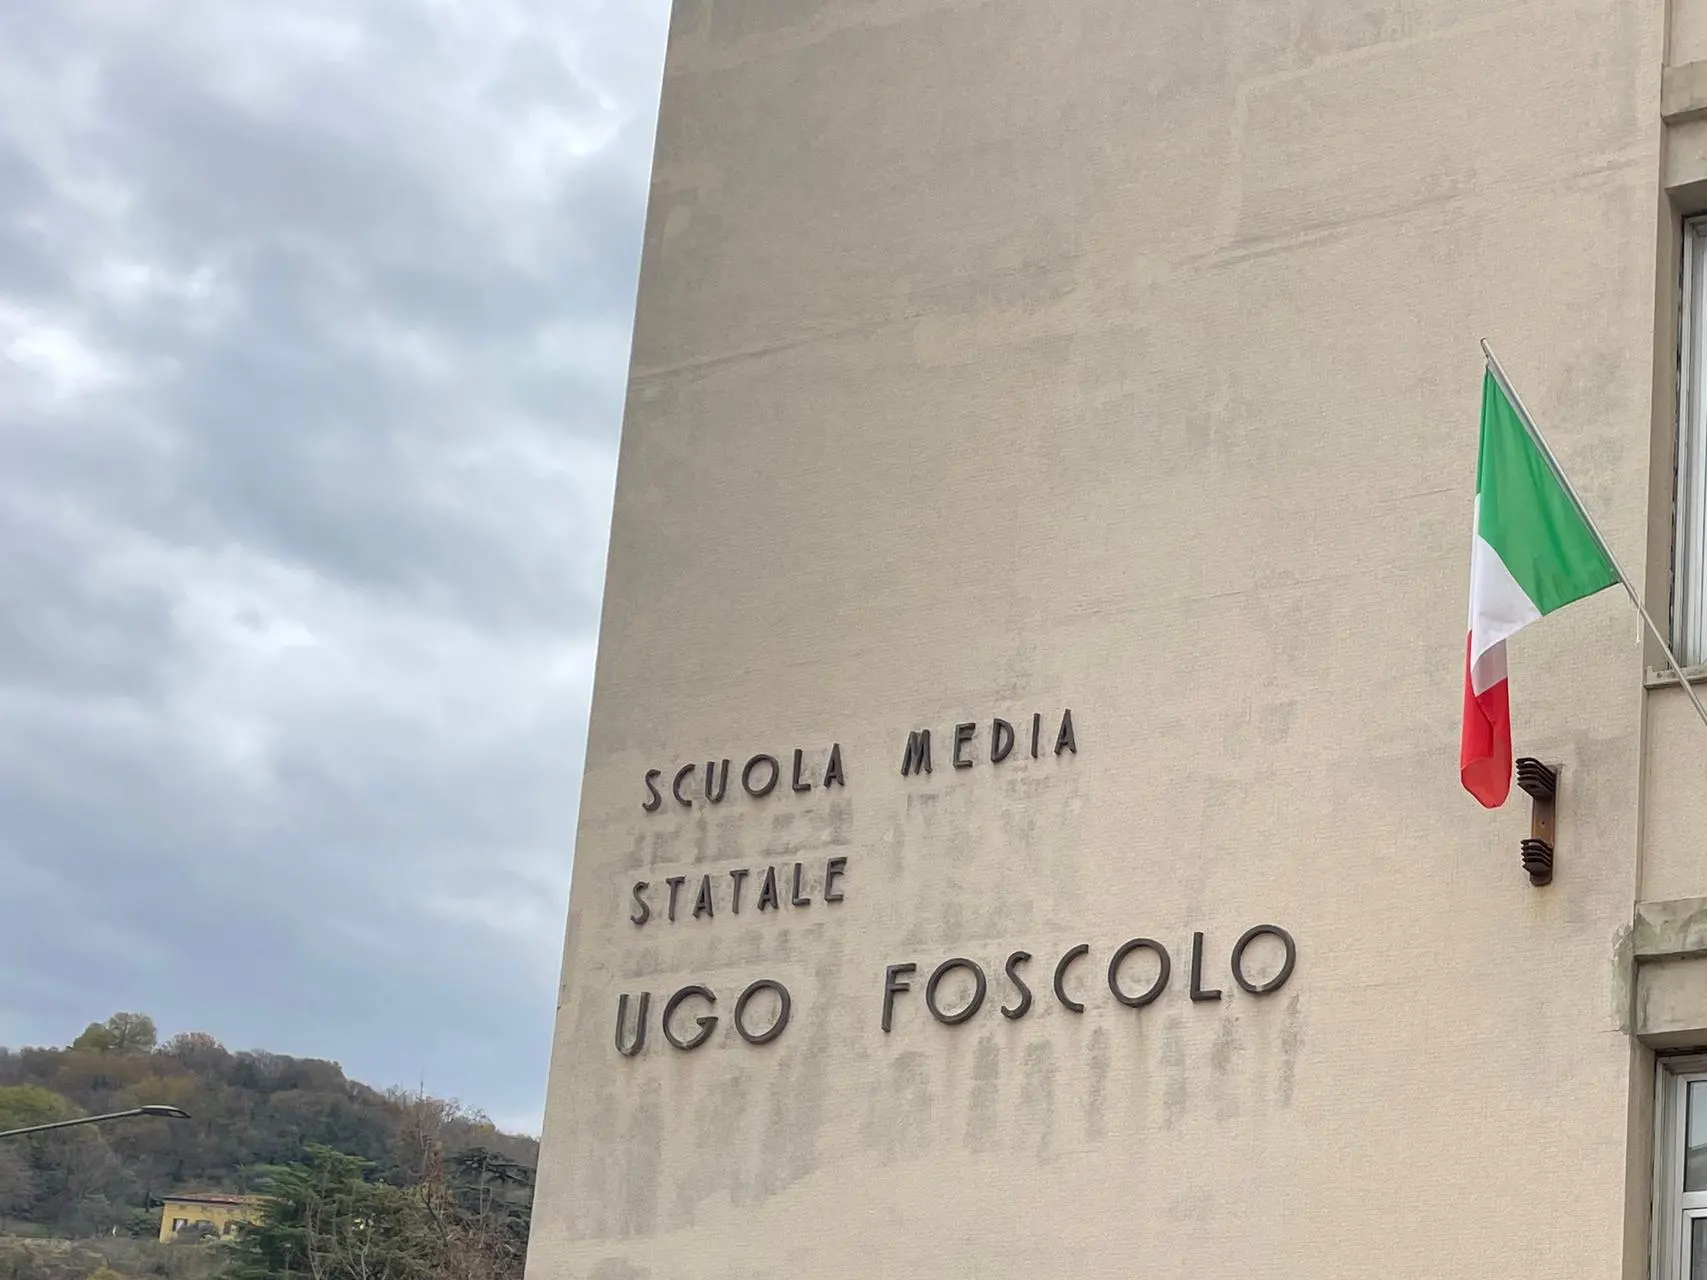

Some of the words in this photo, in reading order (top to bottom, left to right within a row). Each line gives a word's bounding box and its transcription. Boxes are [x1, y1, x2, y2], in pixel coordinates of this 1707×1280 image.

[642, 743, 845, 812] SCUOLA
[901, 708, 1077, 776] MEDIA
[630, 856, 848, 926] STATALE
[614, 979, 792, 1057] UGO
[881, 924, 1297, 1033] FOSCOLO
